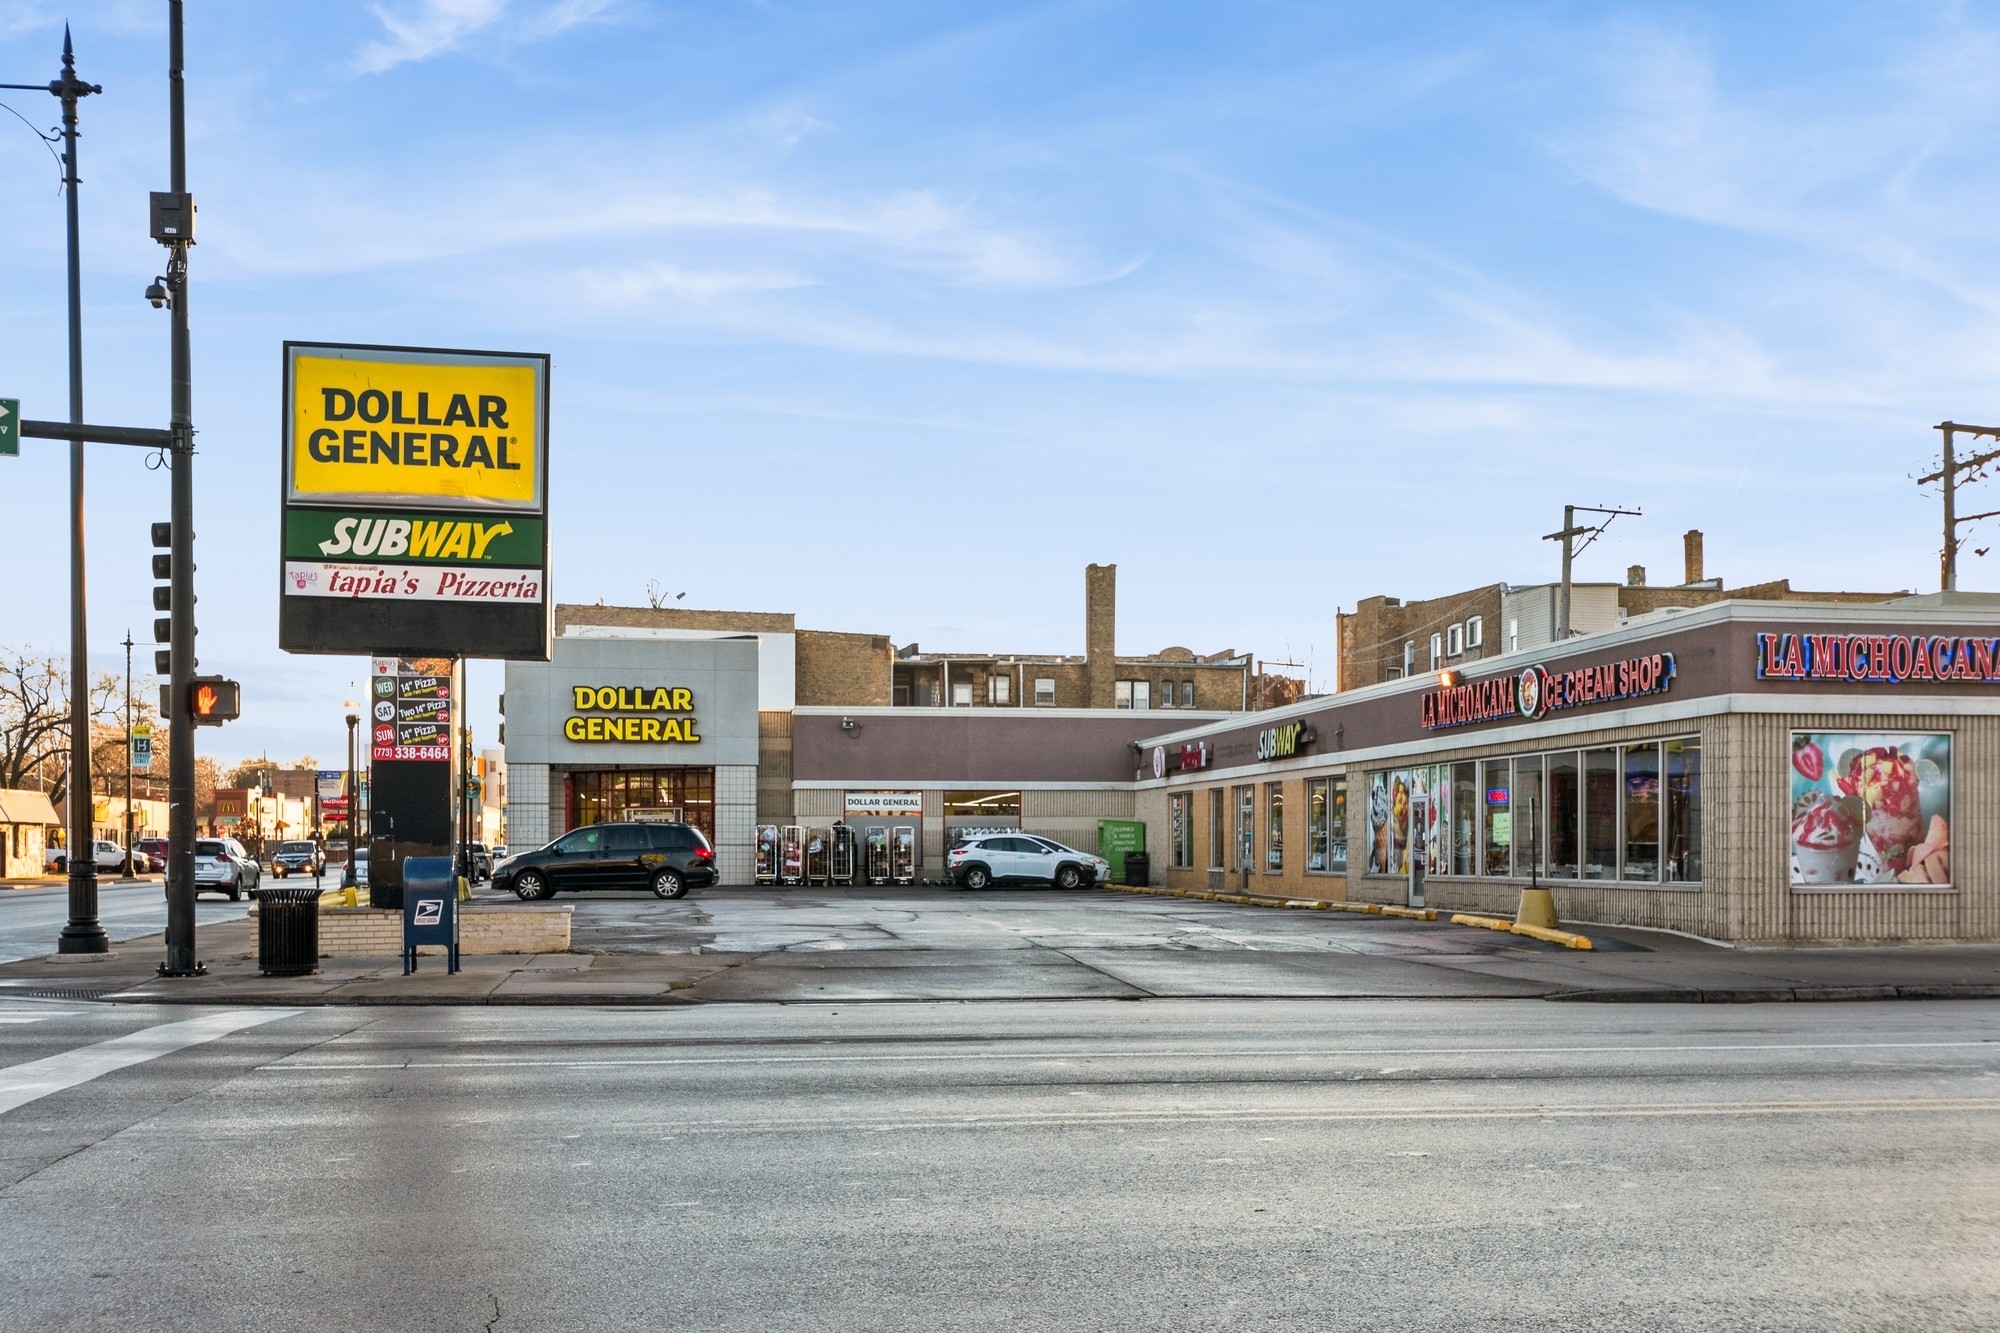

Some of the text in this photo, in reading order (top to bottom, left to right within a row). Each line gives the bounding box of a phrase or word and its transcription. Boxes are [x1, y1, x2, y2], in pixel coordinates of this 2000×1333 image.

[321, 387, 509, 429] DOLLAR
[308, 428, 521, 470] GENERAL
[318, 517, 514, 559] SUBWAY
[328, 570, 539, 598] tapia's Pizzeria
[1765, 633, 1805, 677] LA
[376, 682, 393, 694] WED
[414, 678, 437, 690] Pizza
[1541, 674, 1563, 708] ICE
[1566, 663, 1615, 703] CREAM
[1619, 654, 1662, 695] SHOP
[400, 709, 415, 718] Two
[427, 701, 447, 712] Pizza
[574, 686, 693, 711] DOLLAR
[1421, 693, 1435, 728] LA
[1437, 675, 1515, 726] MICHOACANA
[377, 705, 392, 718] SAT
[376, 729, 394, 741] SUN
[414, 725, 437, 737] Pizza
[565, 717, 700, 742] GENERAL
[1257, 722, 1301, 760] SUBWAY
[374, 747, 449, 759] (773) 338-6464
[847, 798, 920, 806] DOLLAR GENERAL
